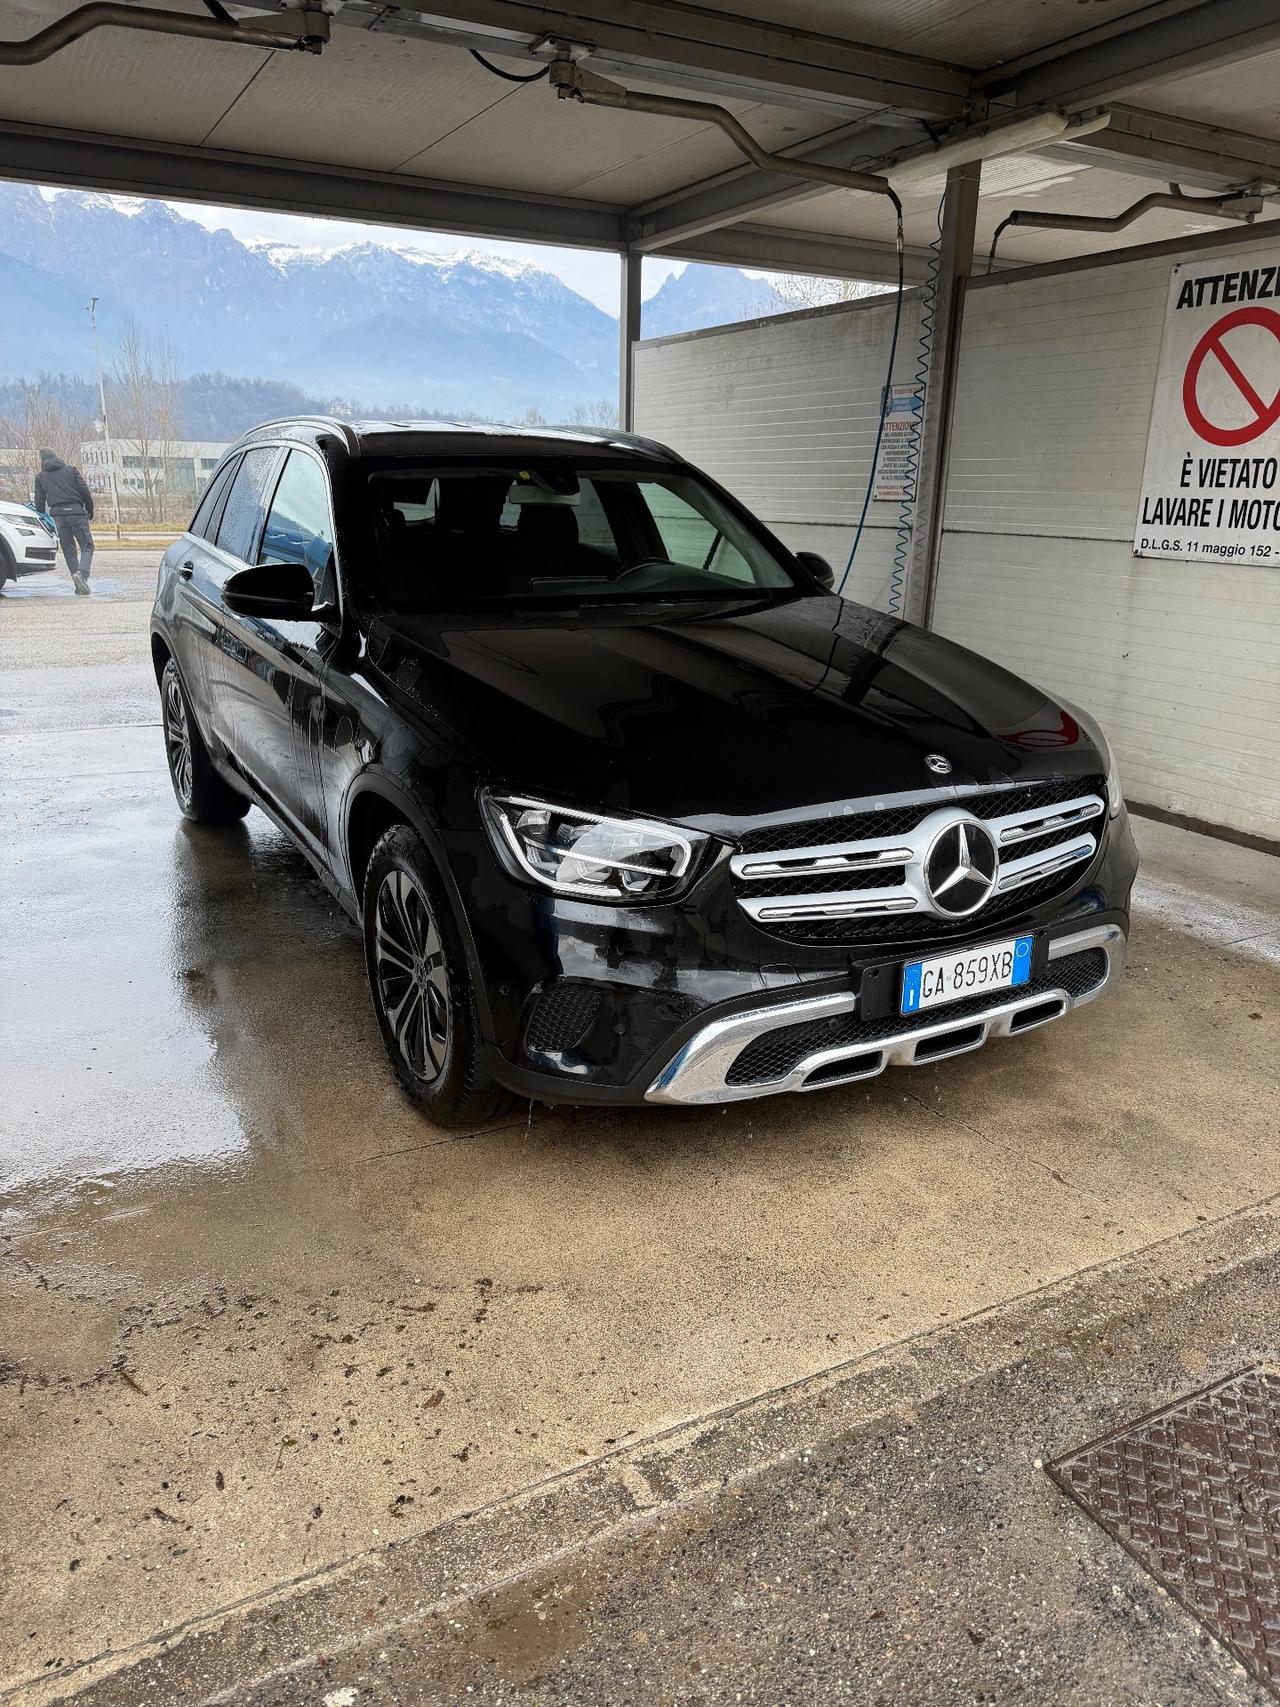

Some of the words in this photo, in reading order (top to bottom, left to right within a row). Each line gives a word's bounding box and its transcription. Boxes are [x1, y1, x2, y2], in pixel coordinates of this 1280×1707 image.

[1180, 452, 1193, 488] È
[1199, 458, 1278, 489] VIETATO
[1142, 497, 1213, 527] LAVARE
[1216, 499, 1225, 528] I
[1141, 538, 1182, 551] D.L.G.S.
[1187, 541, 1199, 552] 11
[1202, 544, 1246, 557] maggio
[1250, 545, 1271, 557] 152
[923, 967, 945, 998] GA
[953, 951, 1013, 990] 859XB
